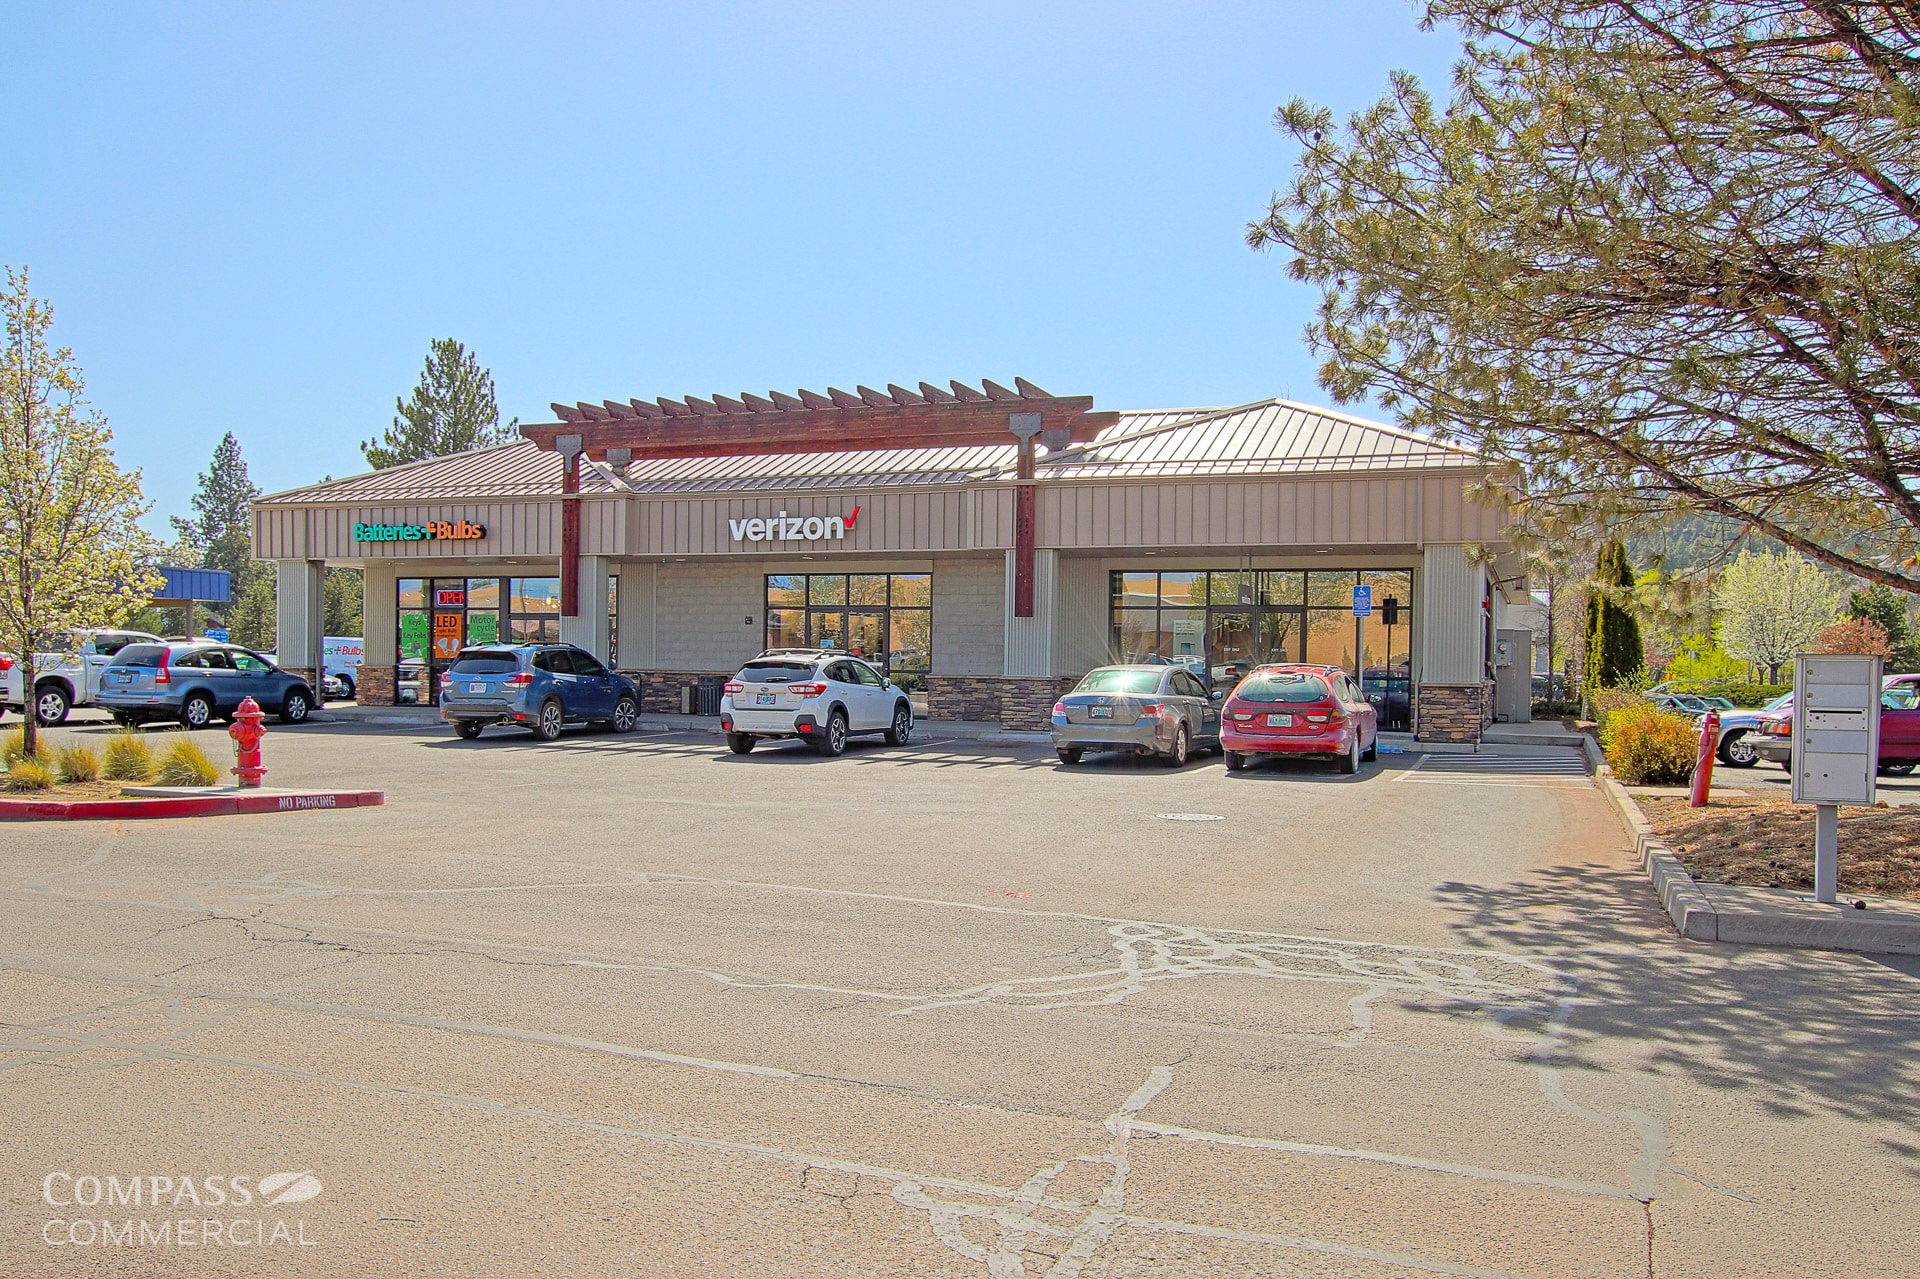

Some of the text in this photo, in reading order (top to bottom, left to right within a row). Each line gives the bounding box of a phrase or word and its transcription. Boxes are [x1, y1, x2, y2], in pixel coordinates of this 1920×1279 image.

[729, 510, 844, 541] verizon
[436, 616, 457, 628] LED
[476, 624, 495, 633] cycle
[403, 632, 413, 640] Key
[279, 795, 336, 809] NO PARKING
